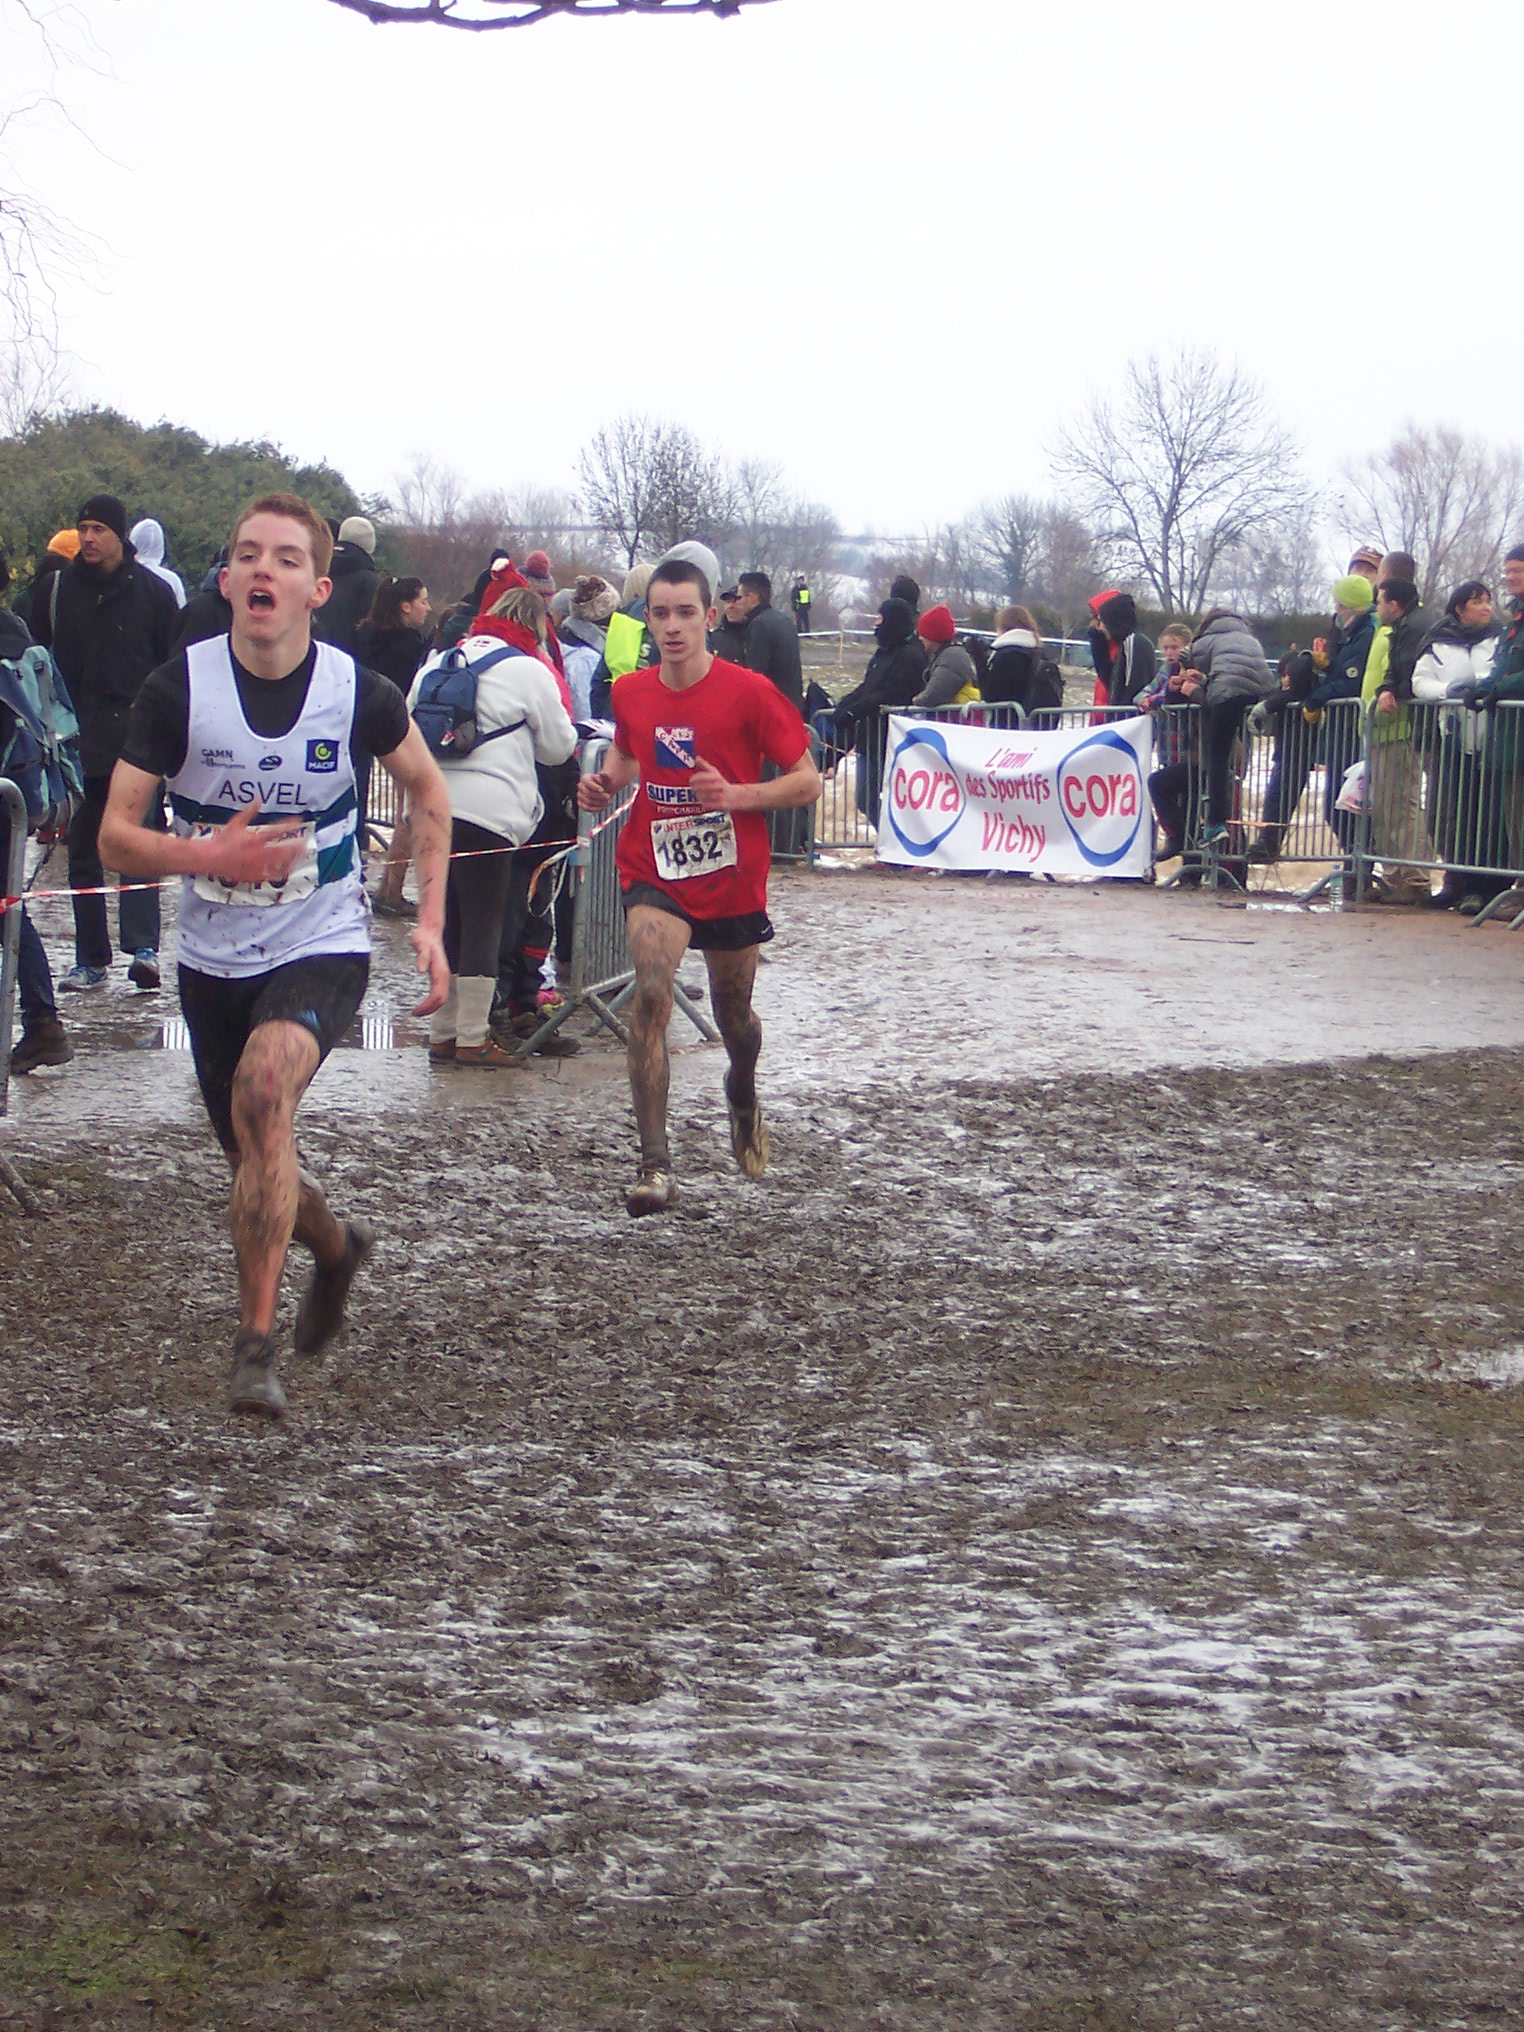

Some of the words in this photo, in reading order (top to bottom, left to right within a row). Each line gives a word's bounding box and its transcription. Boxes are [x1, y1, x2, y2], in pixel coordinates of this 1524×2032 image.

[308, 761, 336, 770] MACIF
[985, 747, 1038, 768] L'ami
[218, 779, 308, 806] ASVEL
[894, 768, 961, 812] cora
[965, 771, 987, 798] des
[988, 769, 1050, 804] Sportifs
[1063, 772, 1137, 818] cora
[657, 831, 723, 868] 1832
[981, 812, 1046, 863] Vichy
